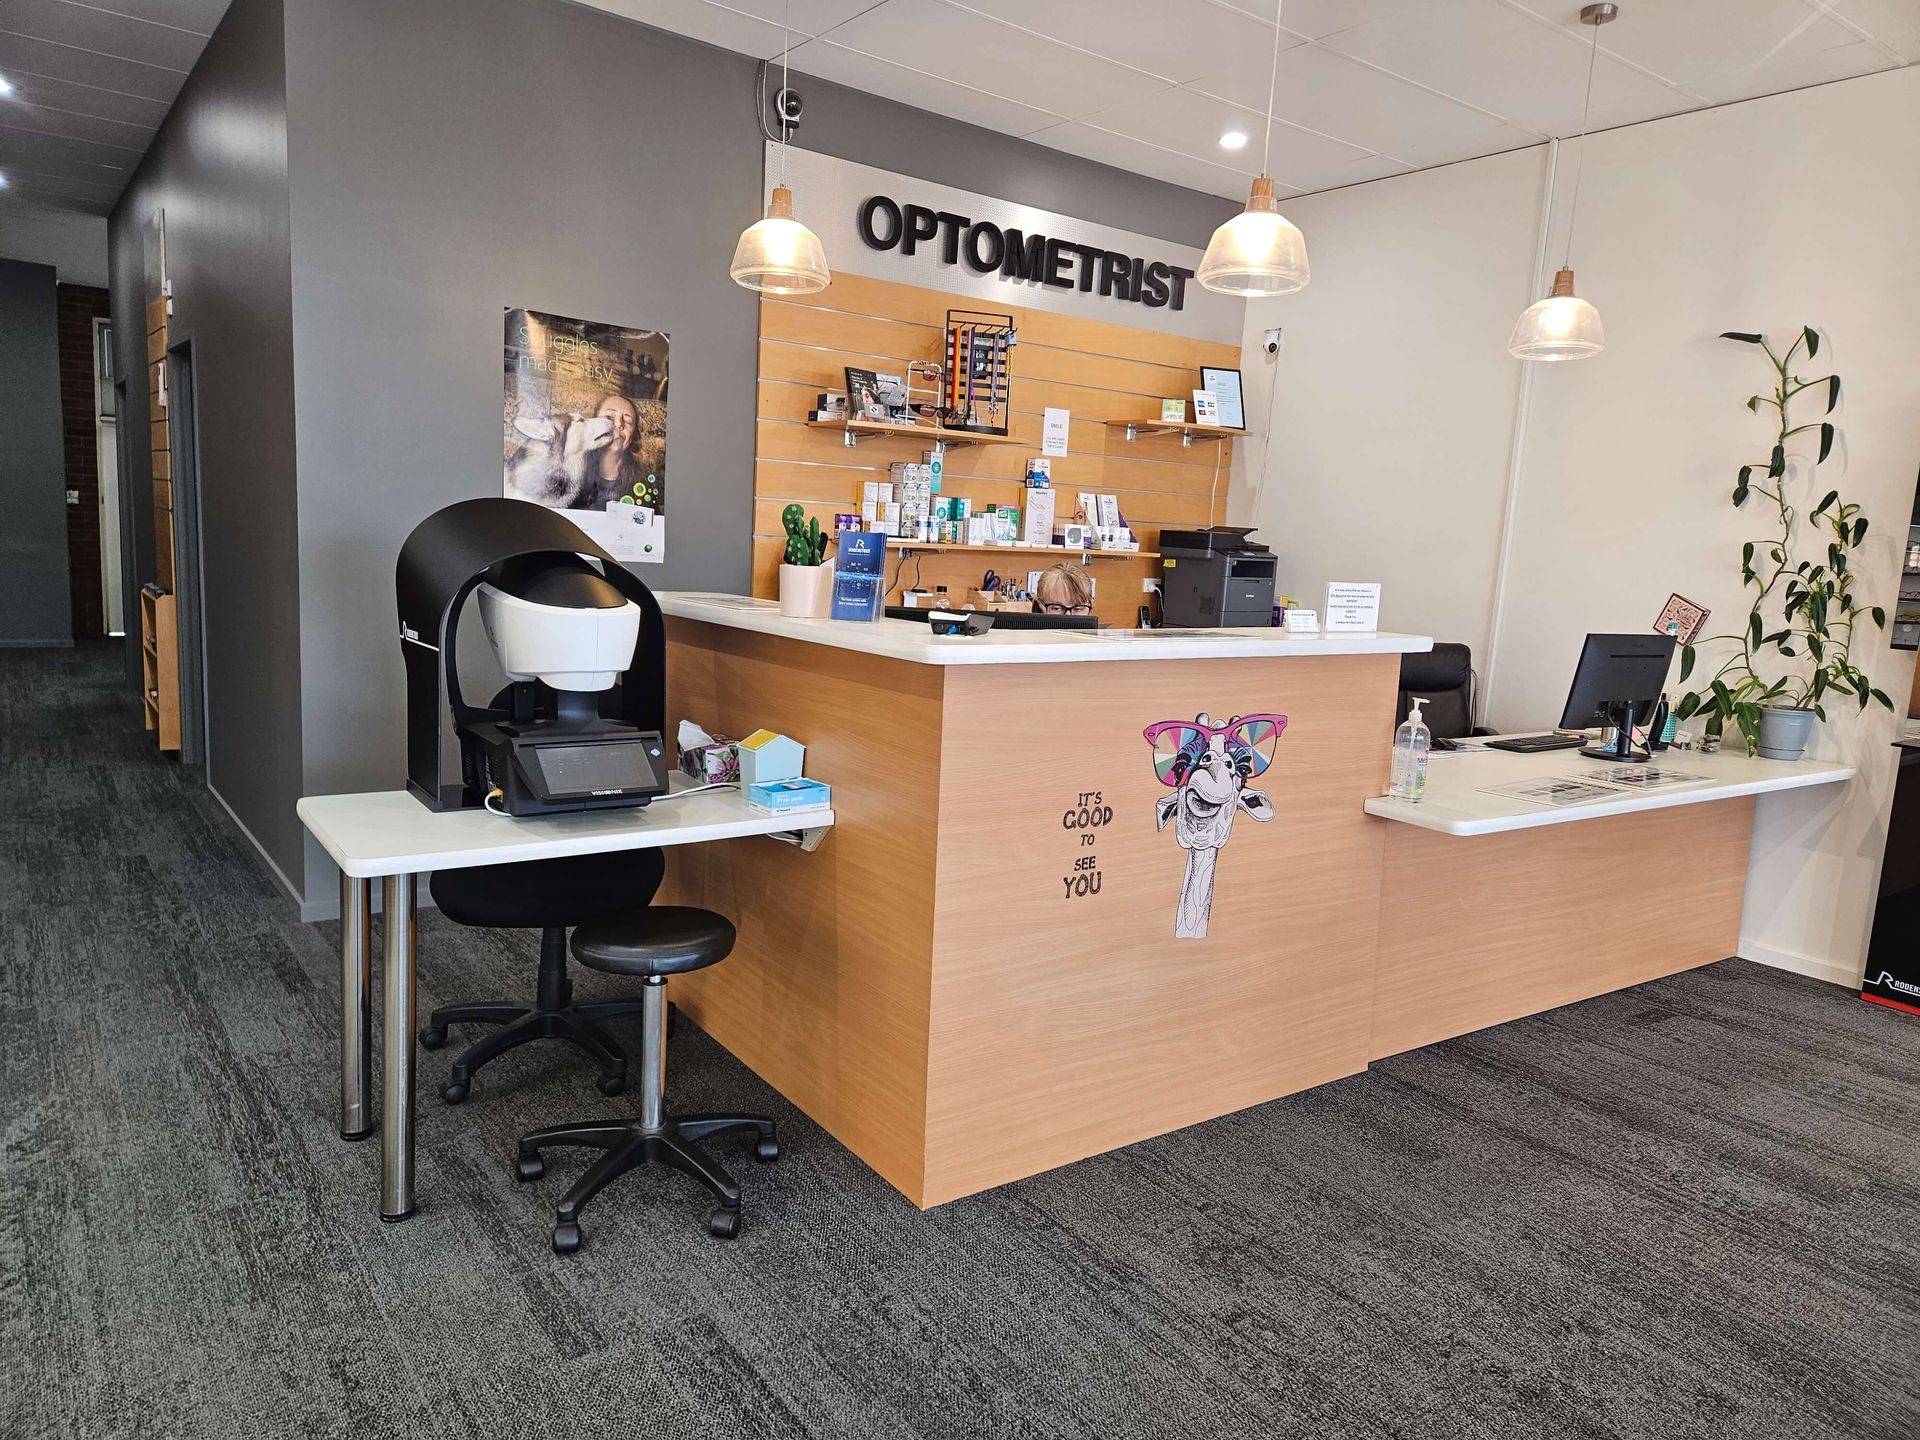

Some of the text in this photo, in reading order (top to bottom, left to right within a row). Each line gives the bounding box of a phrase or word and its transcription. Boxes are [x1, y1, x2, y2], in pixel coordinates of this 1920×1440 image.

[859, 195, 1194, 311] OPTOMETRIST
[519, 326, 598, 356] Suggles
[519, 354, 567, 373] mad
[1077, 791, 1103, 808] IT'S
[1062, 805, 1114, 830] GOOD
[1080, 833, 1095, 847] TO
[1073, 856, 1096, 871] SEE
[1063, 871, 1102, 899] YOU
